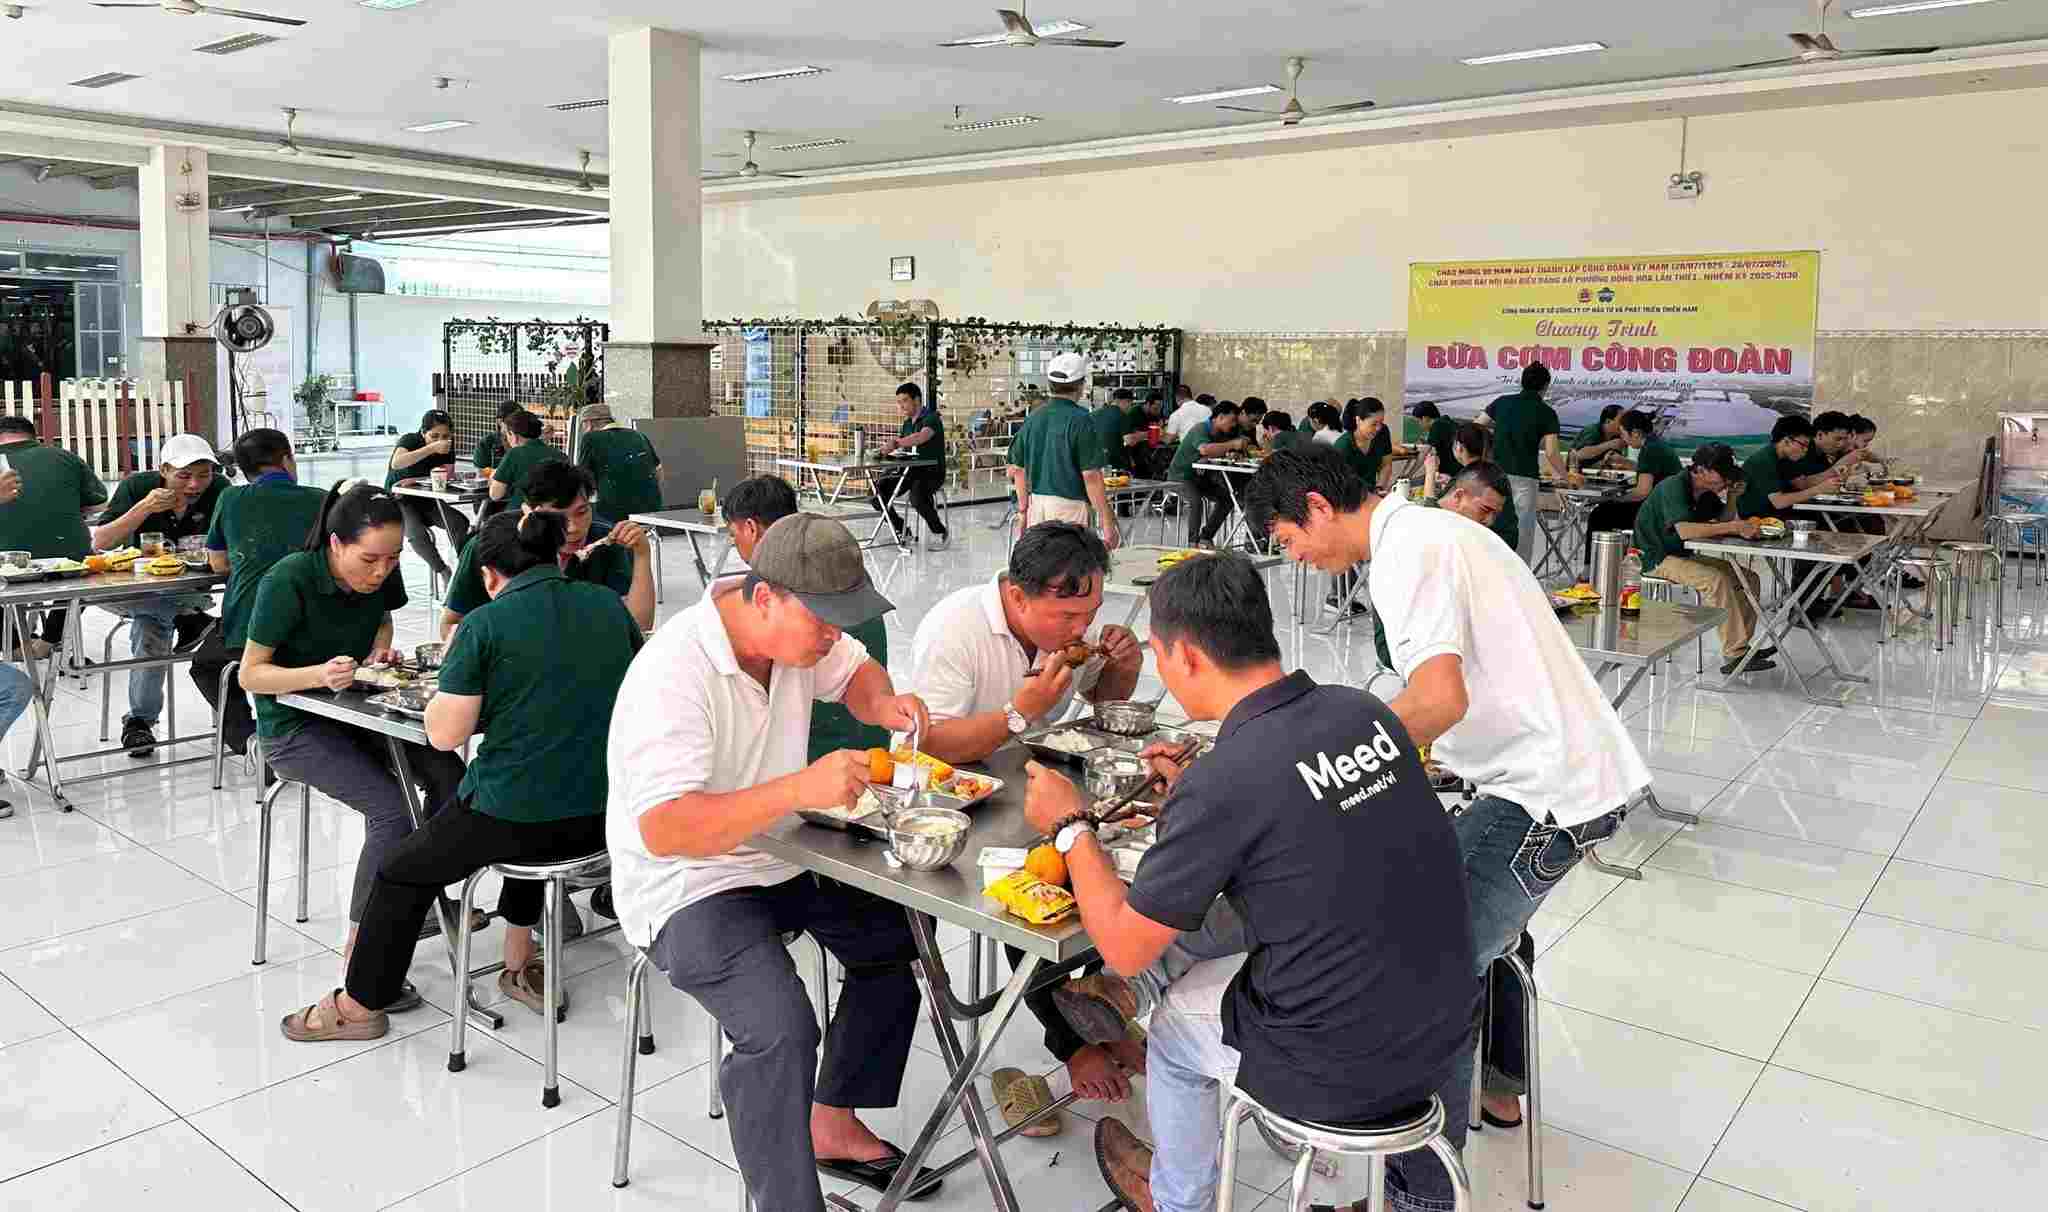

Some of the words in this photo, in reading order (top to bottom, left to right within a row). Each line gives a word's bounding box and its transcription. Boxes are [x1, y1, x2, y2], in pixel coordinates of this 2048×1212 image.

[1426, 342, 1488, 369] BỮA
[1497, 343, 1572, 371] CƠM
[1582, 341, 1678, 373] CÔNG
[1686, 341, 1793, 375] ĐOÀN
[1296, 720, 1401, 800] Meed
[1339, 770, 1397, 811] meed.net/vi
